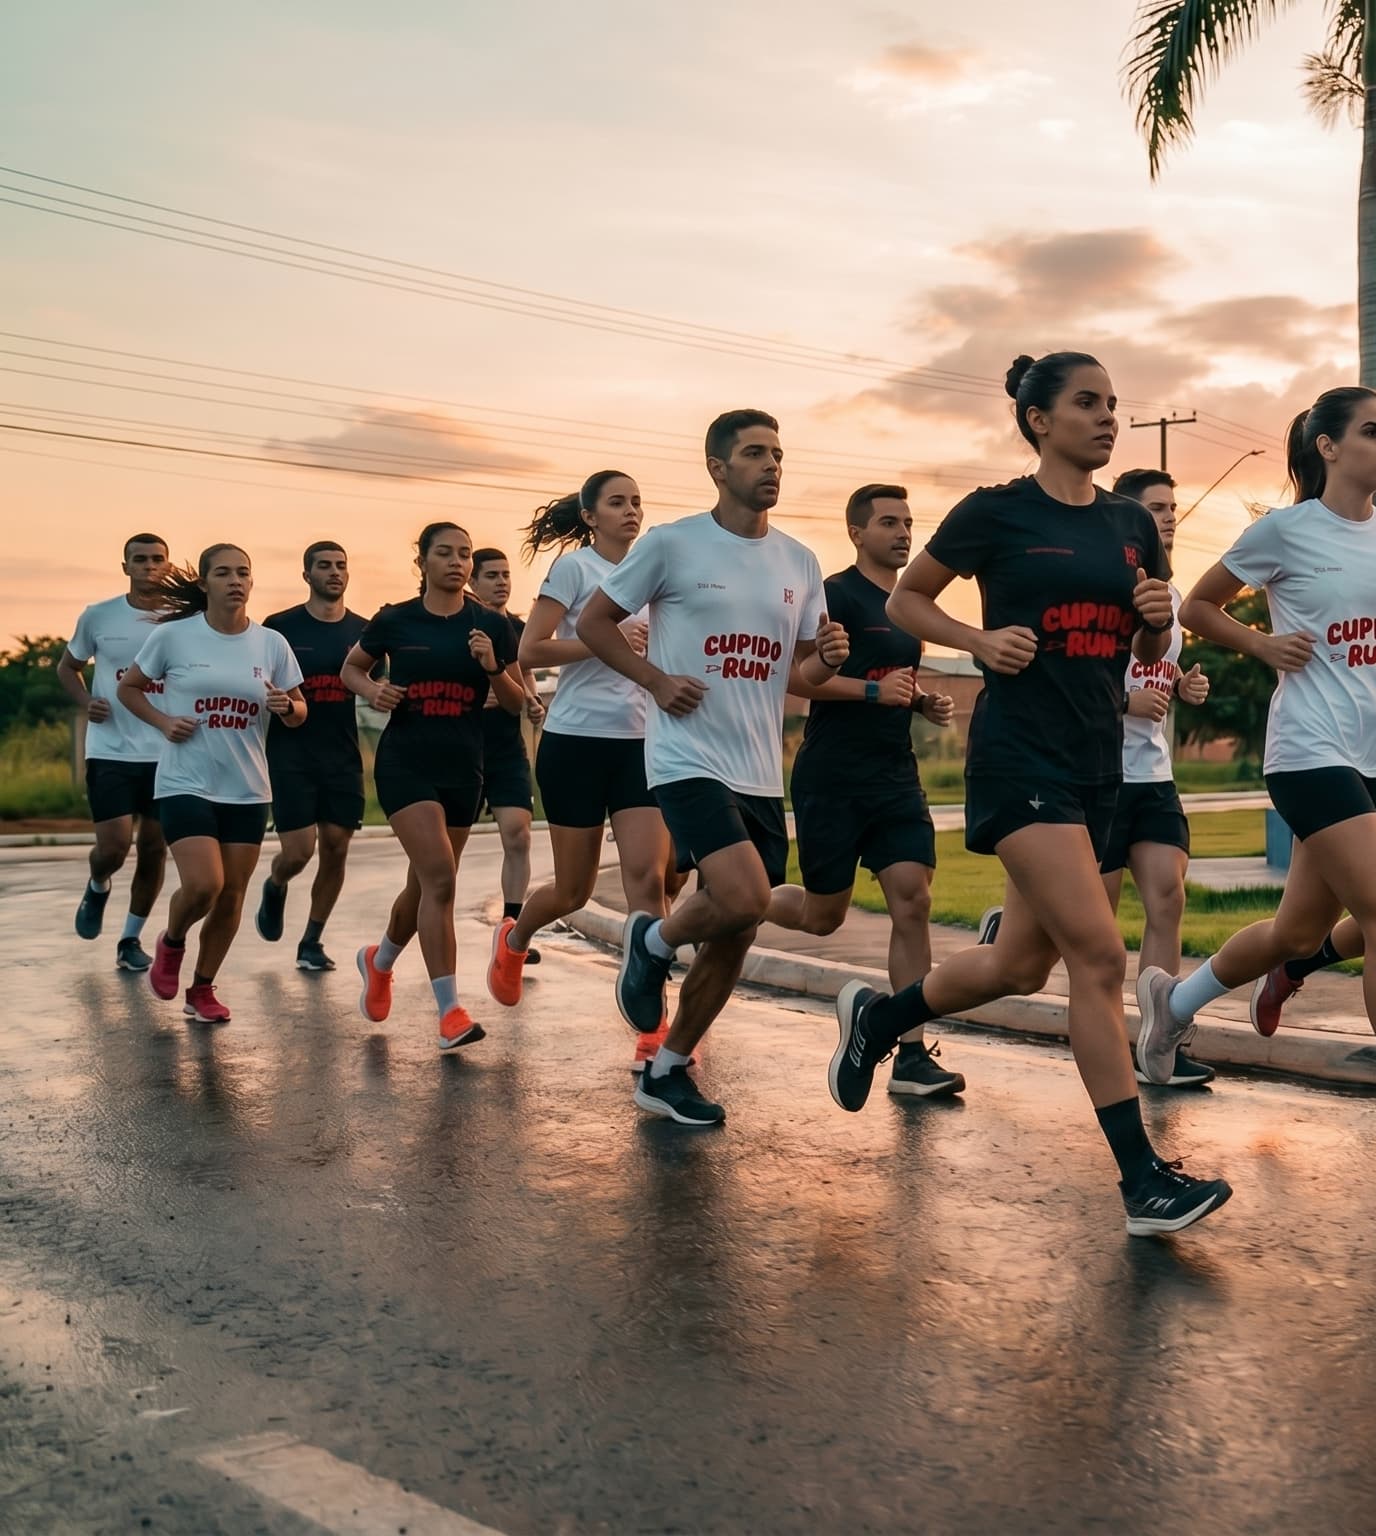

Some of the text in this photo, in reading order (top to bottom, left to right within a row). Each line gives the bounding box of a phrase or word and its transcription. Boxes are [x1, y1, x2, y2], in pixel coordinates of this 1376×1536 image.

[1042, 602, 1132, 636] CUPIDO
[704, 633, 782, 662] CUPIDO
[1066, 631, 1117, 658] RUN
[722, 657, 770, 682] RUN
[408, 680, 475, 702] CUPIDO
[194, 697, 259, 716] CUPIDO
[423, 699, 462, 717] RUN
[208, 714, 249, 730] RUN
